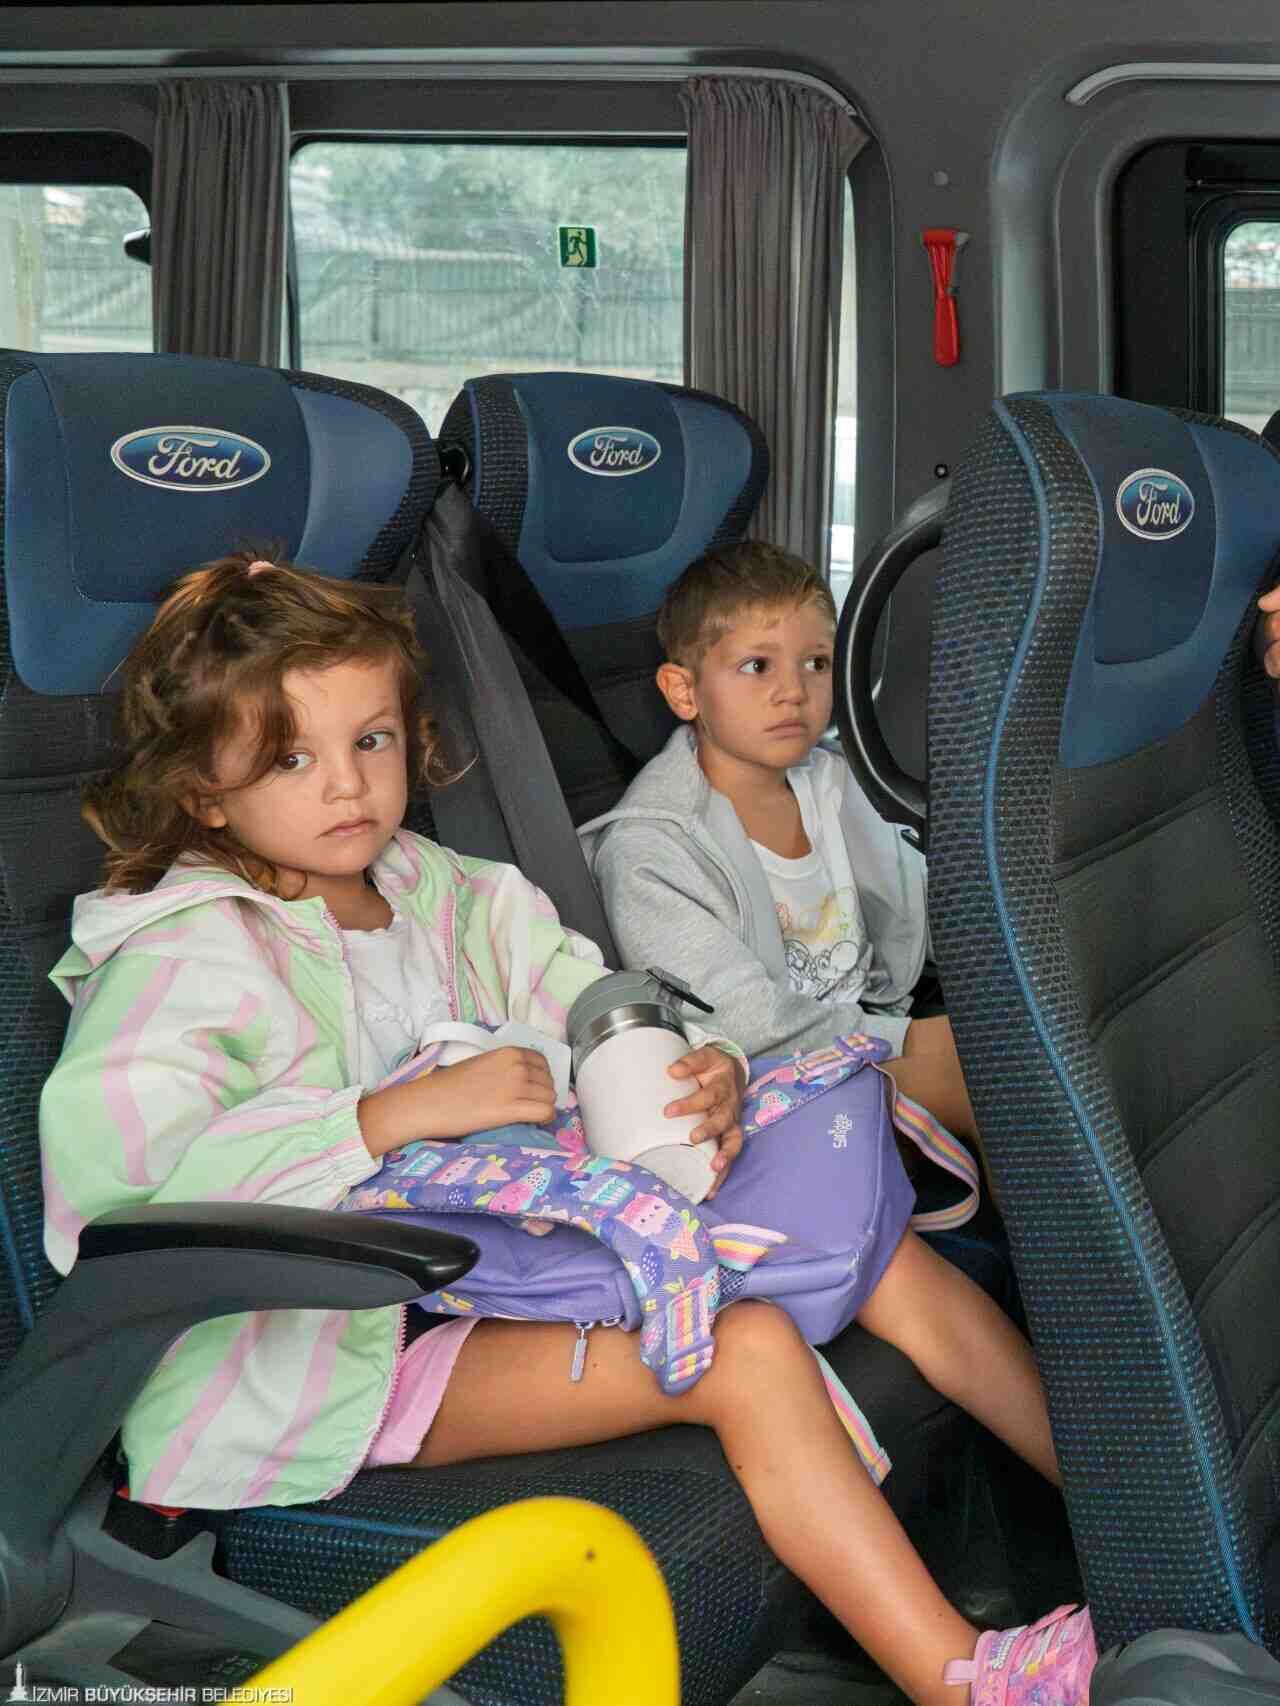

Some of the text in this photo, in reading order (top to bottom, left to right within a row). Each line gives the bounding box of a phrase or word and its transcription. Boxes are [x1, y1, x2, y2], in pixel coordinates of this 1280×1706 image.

[148, 434, 243, 479] Ford
[590, 434, 643, 467] Ford
[1136, 481, 1182, 526] Ford
